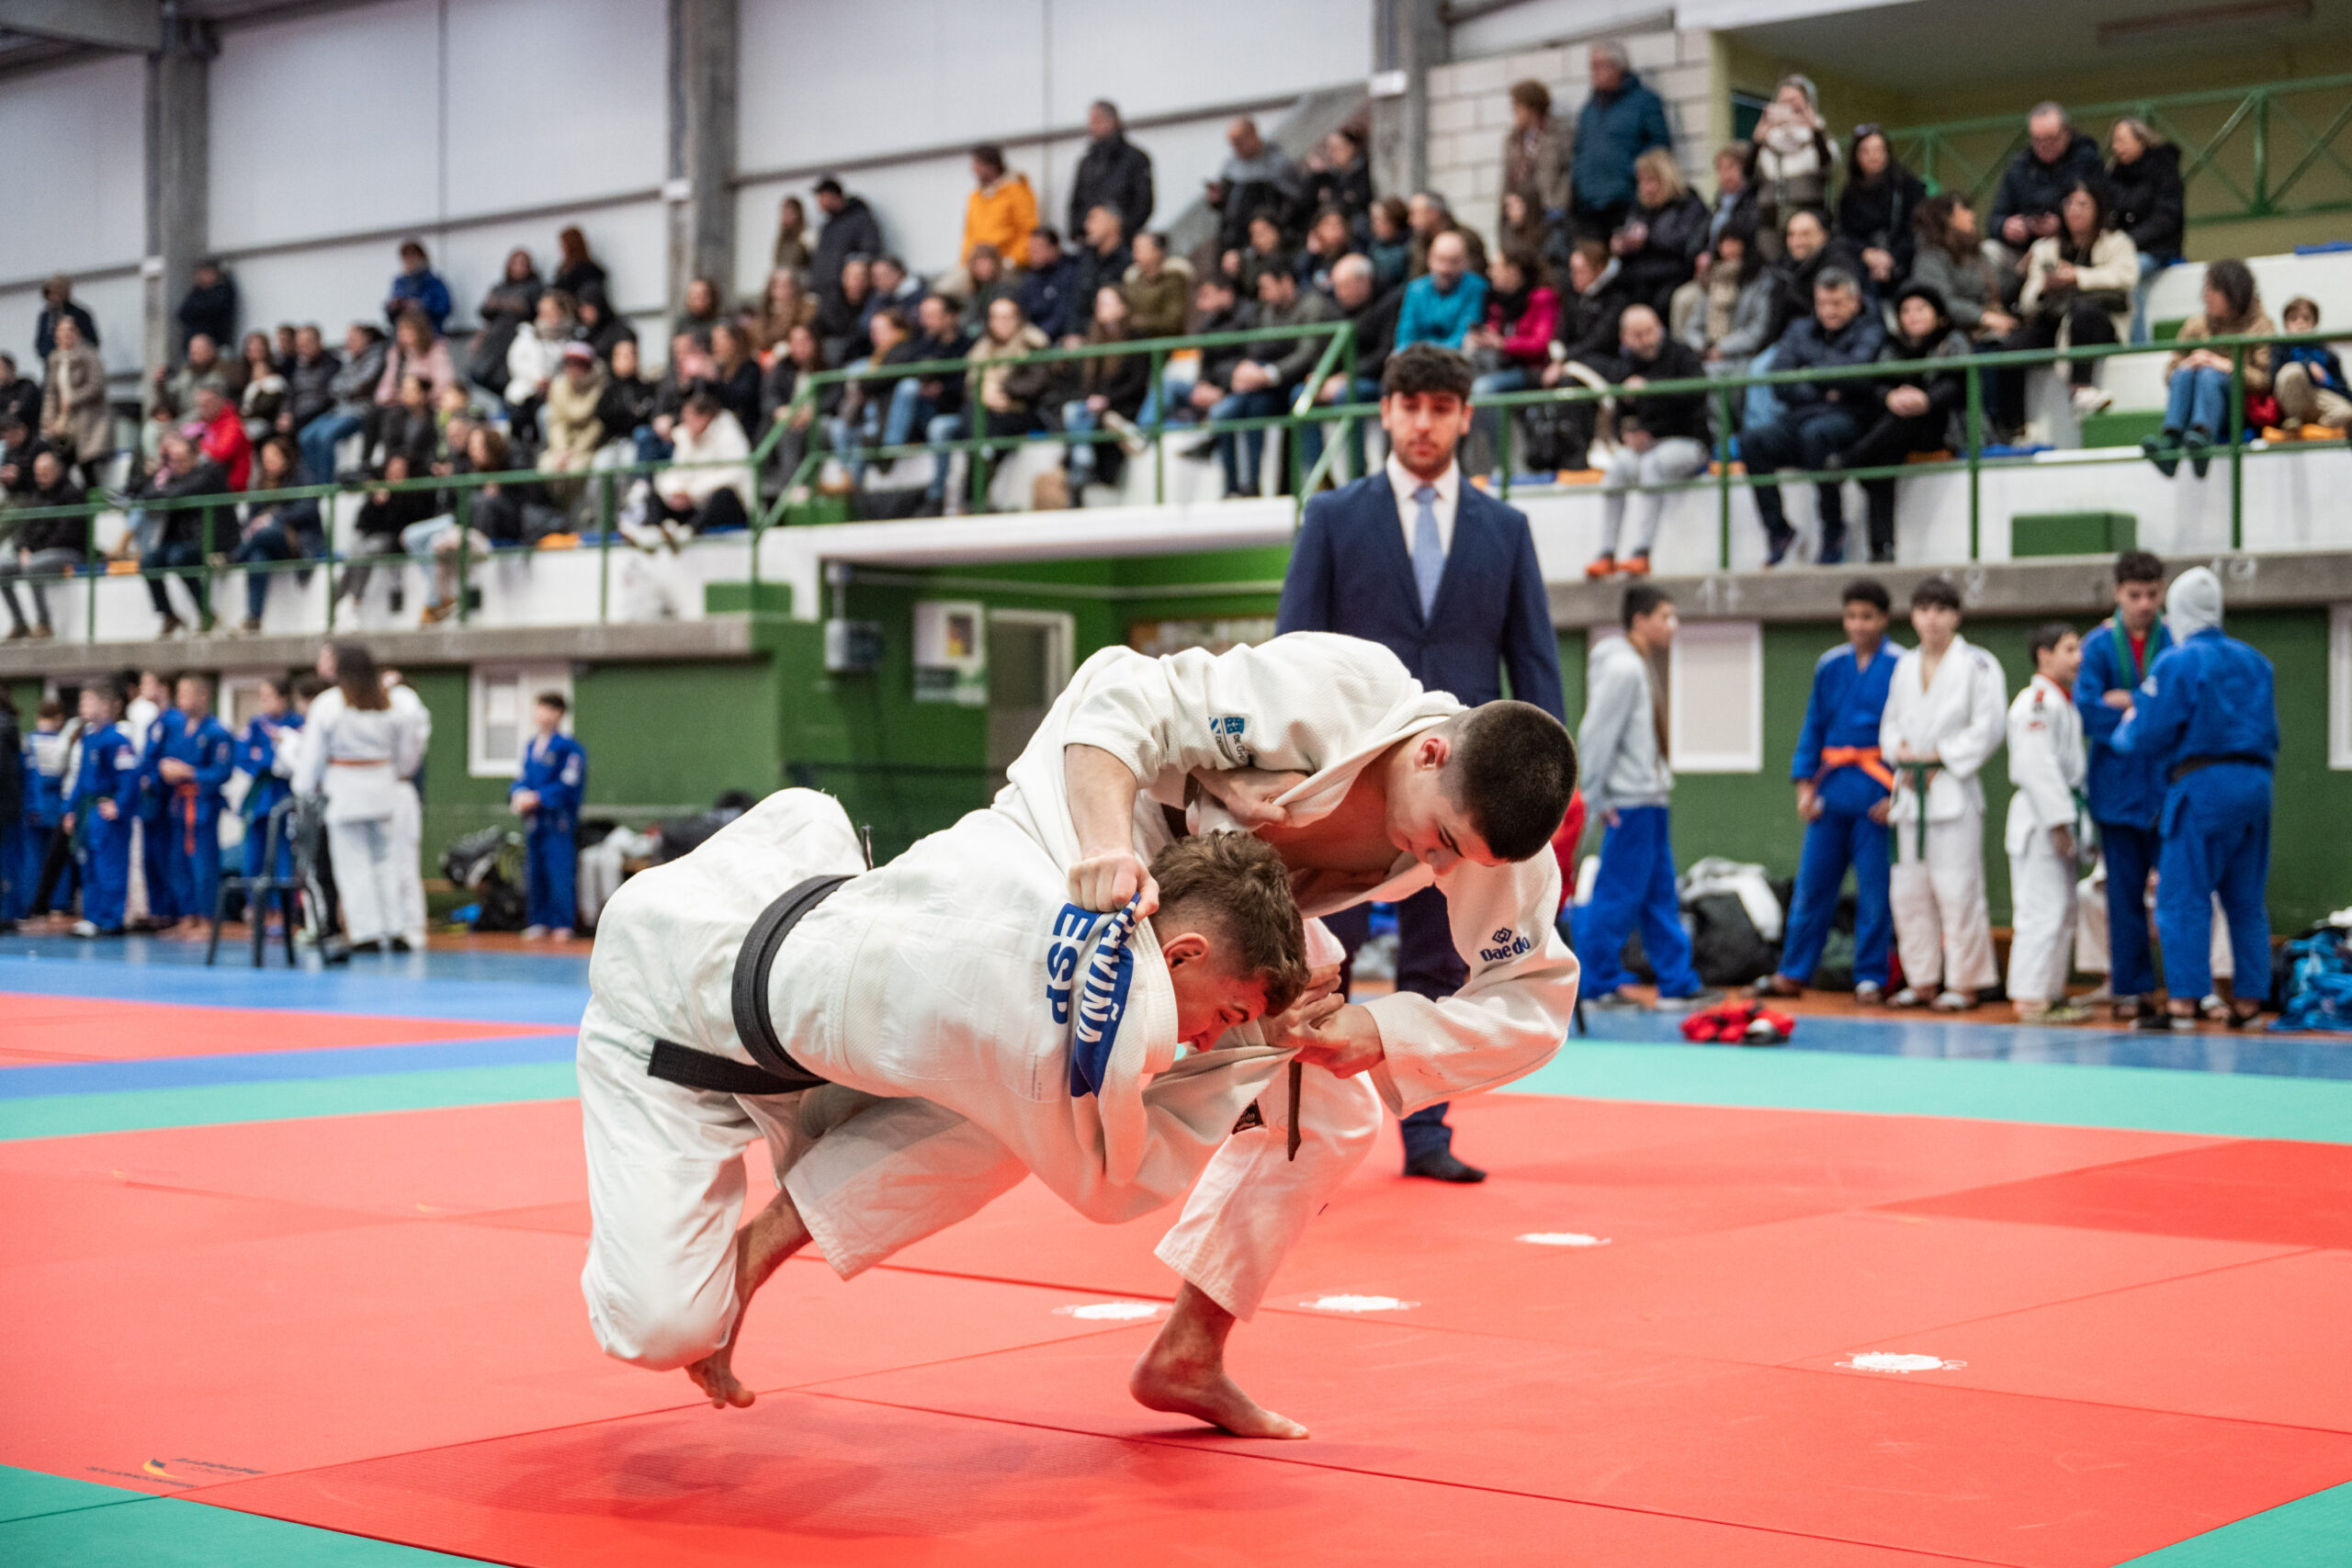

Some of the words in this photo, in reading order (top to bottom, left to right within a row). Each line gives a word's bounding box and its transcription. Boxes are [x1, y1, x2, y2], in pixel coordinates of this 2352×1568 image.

[1046, 902, 1102, 1024] ESP
[1076, 901, 1137, 1042] AVIÑA
[1479, 936, 1531, 963] Daedo
